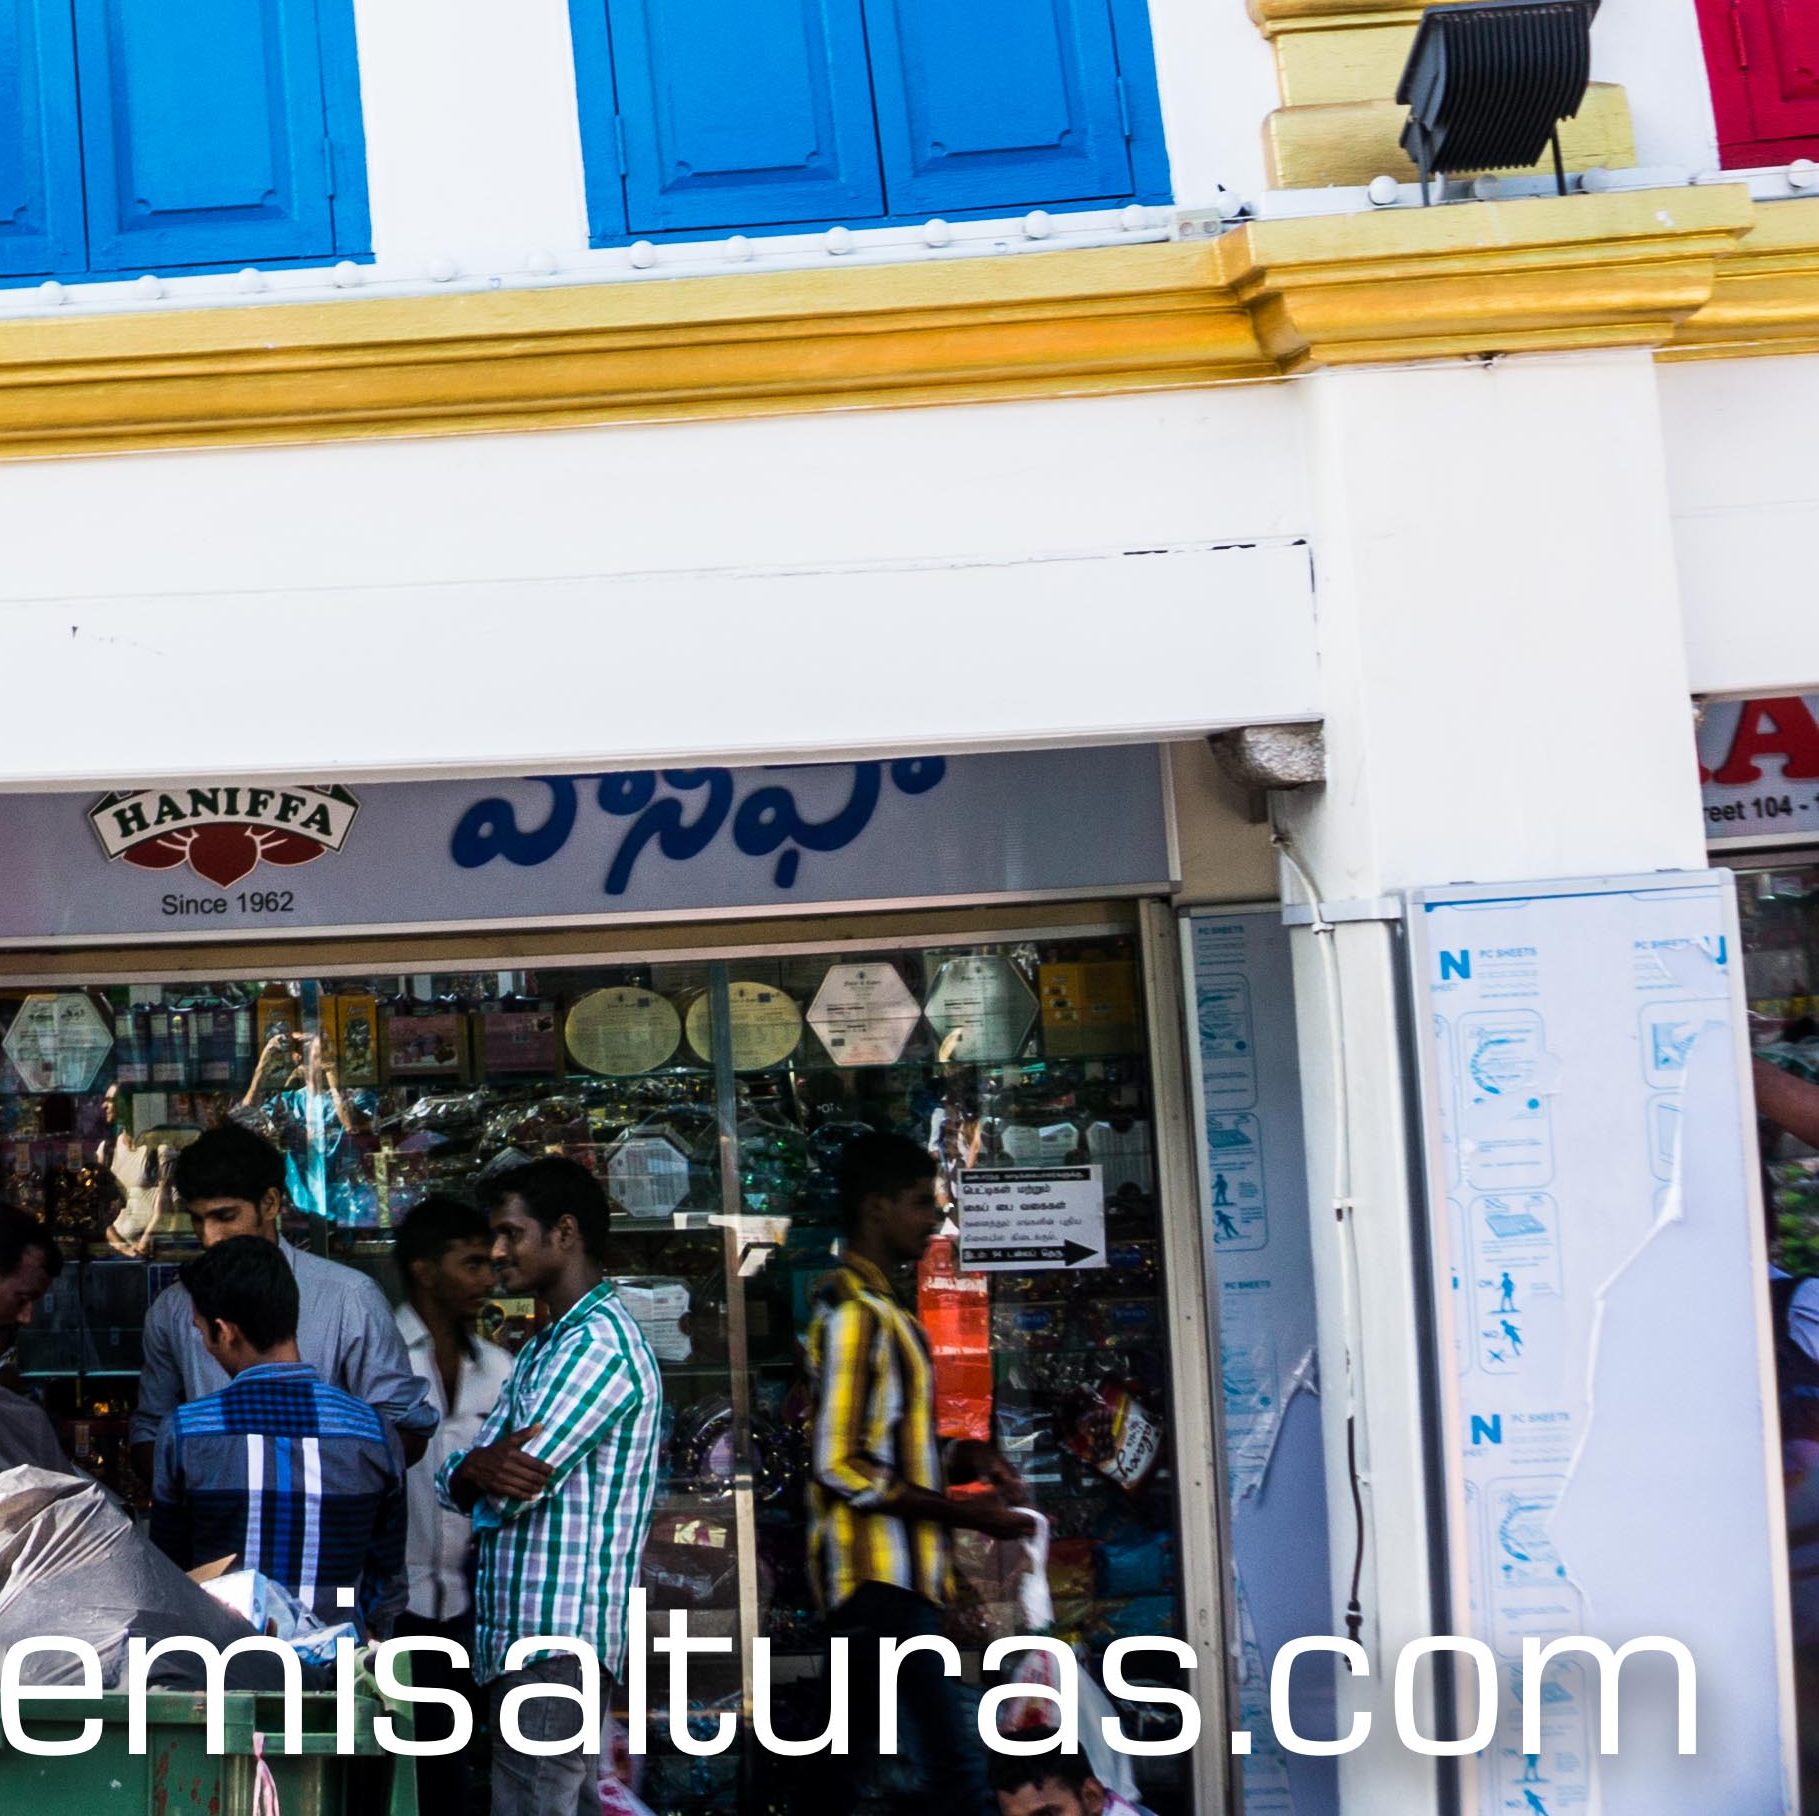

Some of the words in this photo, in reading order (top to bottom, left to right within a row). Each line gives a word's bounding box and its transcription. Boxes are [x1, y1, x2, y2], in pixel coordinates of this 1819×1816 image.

[112, 786, 333, 839] HANIFFA
[1752, 795, 1793, 818] 104
[161, 893, 228, 916] Since
[236, 890, 294, 913] 1962
